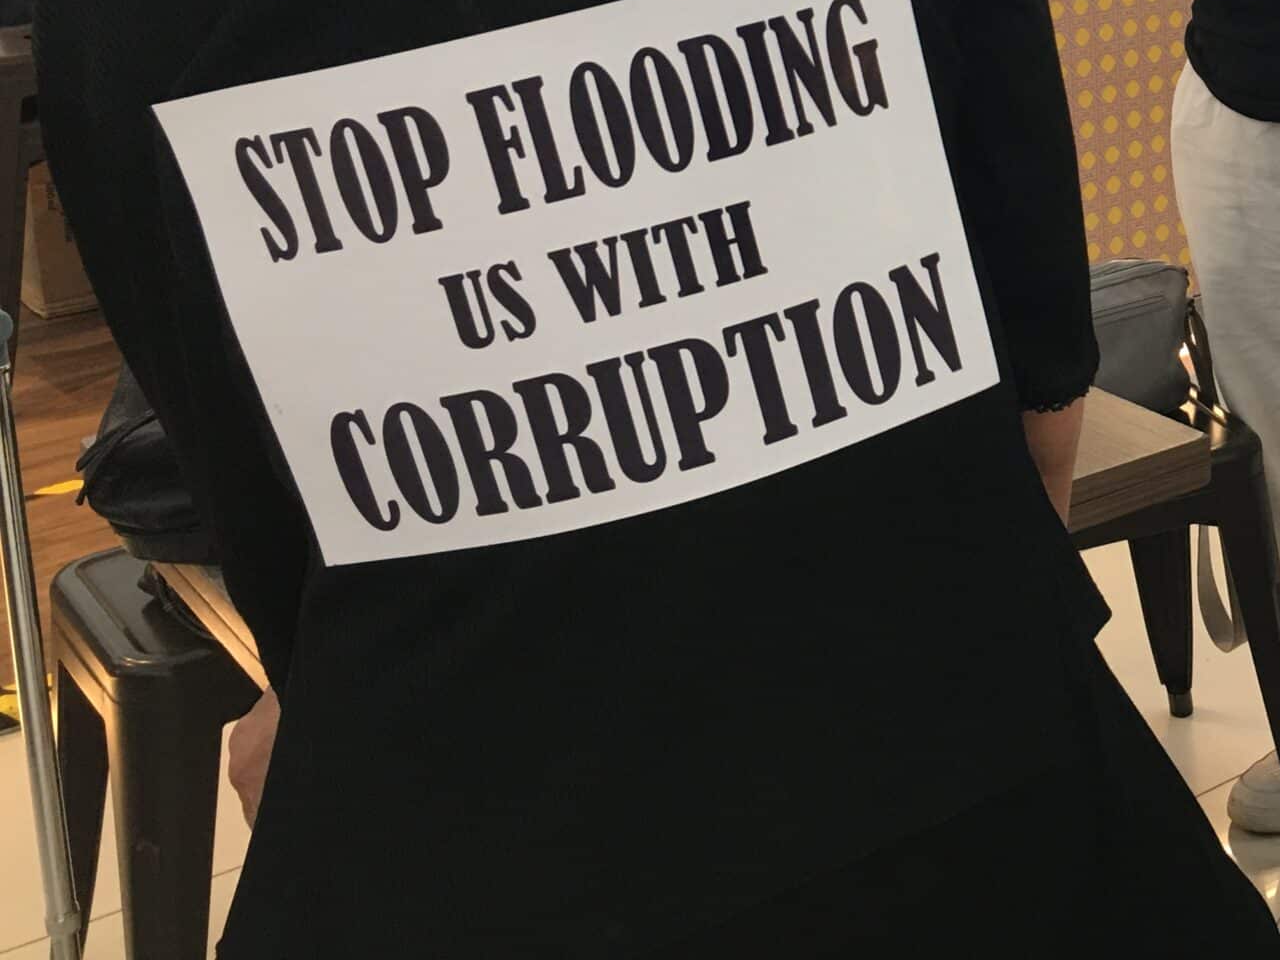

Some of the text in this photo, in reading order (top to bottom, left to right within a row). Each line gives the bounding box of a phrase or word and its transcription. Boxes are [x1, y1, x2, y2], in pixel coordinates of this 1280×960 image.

[235, 105, 451, 263] STOP
[438, 200, 768, 349] US WITH
[329, 252, 963, 533] CORRUPTION
